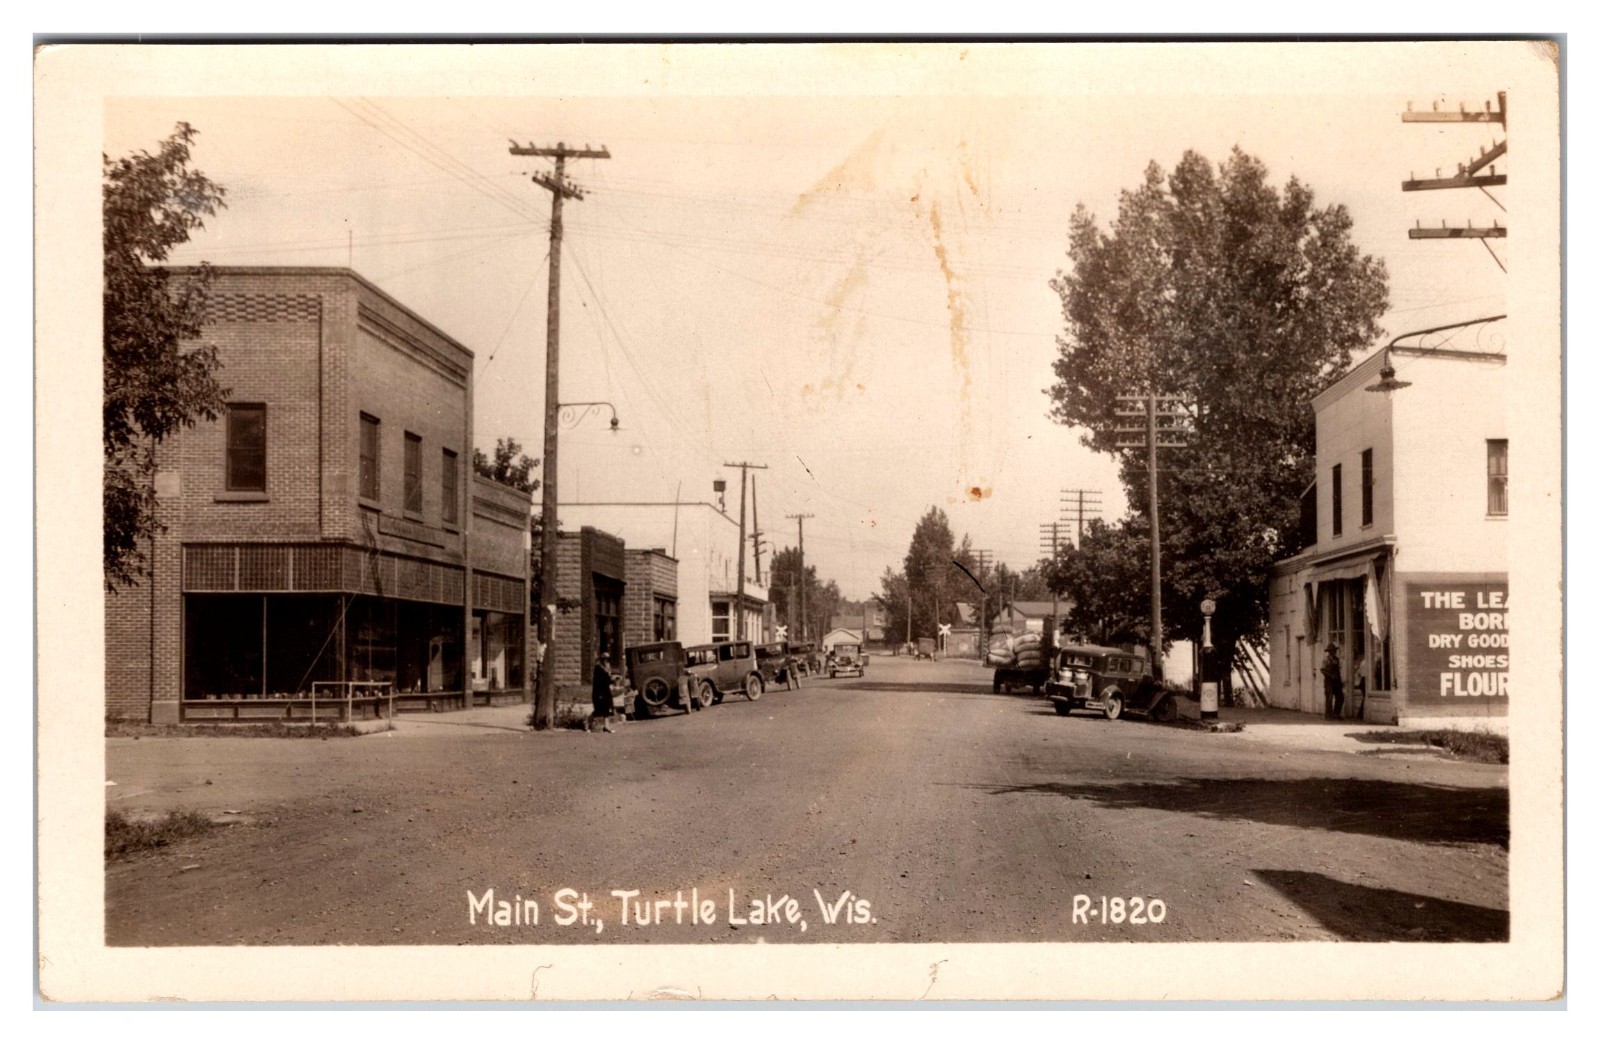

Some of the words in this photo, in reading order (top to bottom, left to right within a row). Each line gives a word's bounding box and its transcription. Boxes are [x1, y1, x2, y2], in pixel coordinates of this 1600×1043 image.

[1420, 591, 1466, 609] THE
[1428, 634, 1463, 648] DRY
[1467, 633, 1509, 648] GOOD
[1448, 654, 1509, 668] SHOES
[1440, 671, 1509, 697] FLOUR
